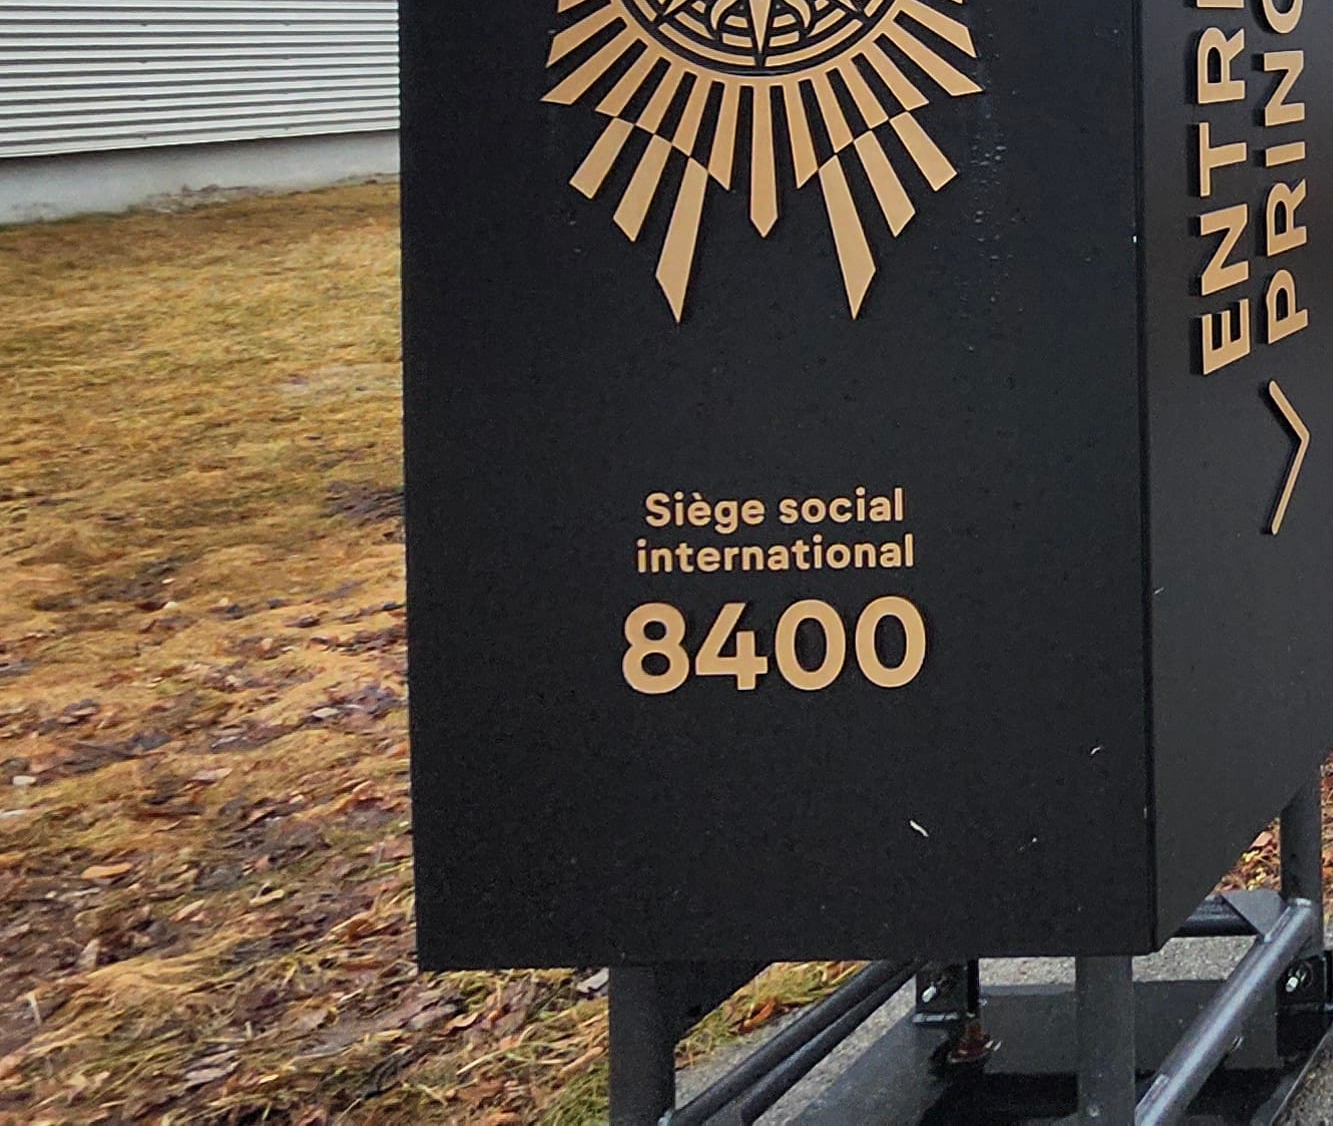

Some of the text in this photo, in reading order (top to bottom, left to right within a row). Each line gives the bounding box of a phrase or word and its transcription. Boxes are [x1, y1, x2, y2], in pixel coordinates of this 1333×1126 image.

[645, 486, 904, 534] Siège social
[636, 533, 914, 573] international
[622, 595, 927, 695] 8400
